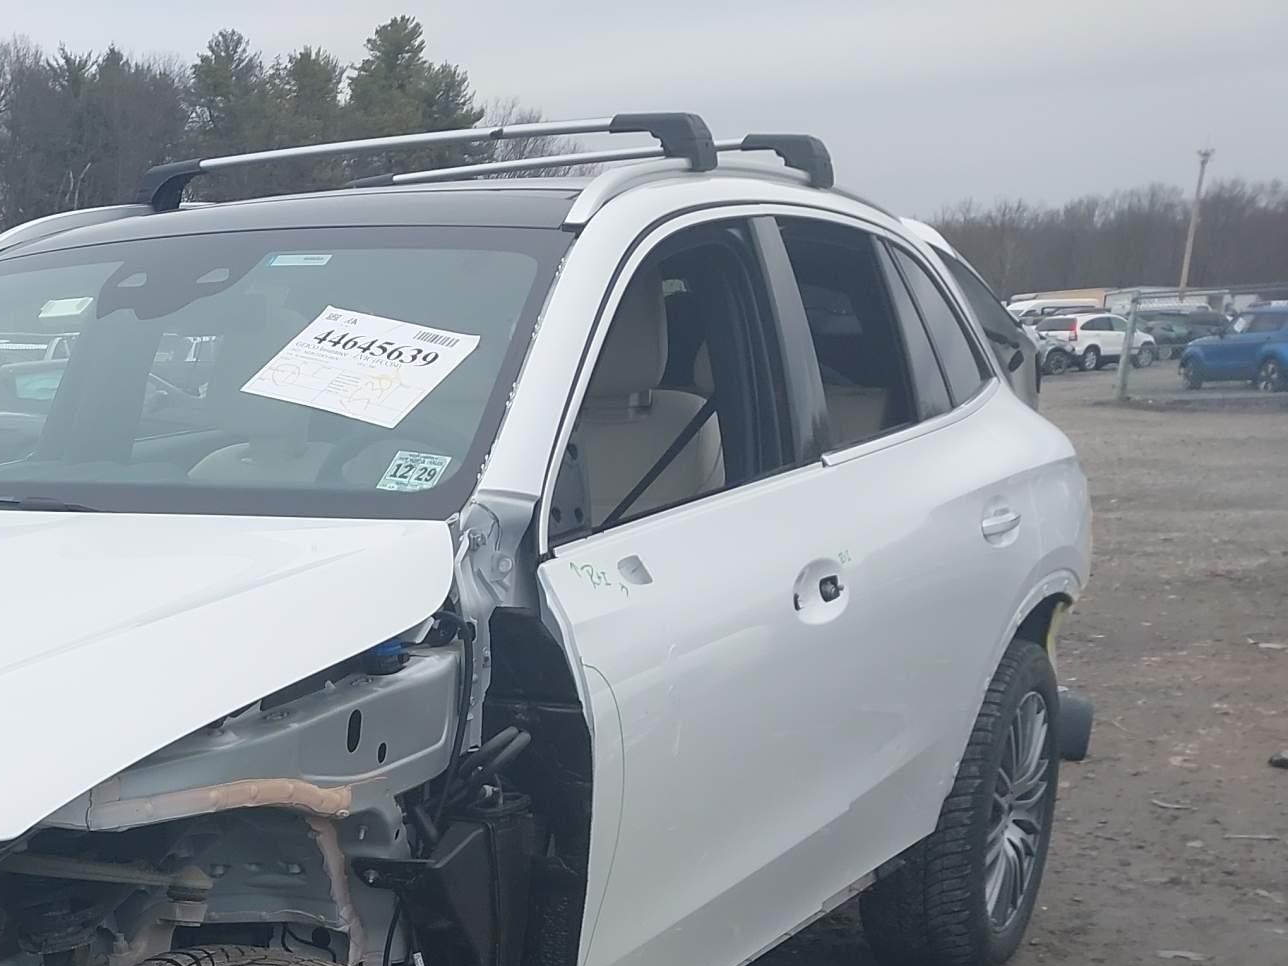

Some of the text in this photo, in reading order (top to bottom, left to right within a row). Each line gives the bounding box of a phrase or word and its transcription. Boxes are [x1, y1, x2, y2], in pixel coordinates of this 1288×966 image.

[313, 329, 439, 368] 44645639
[389, 463, 437, 482] 12 29
